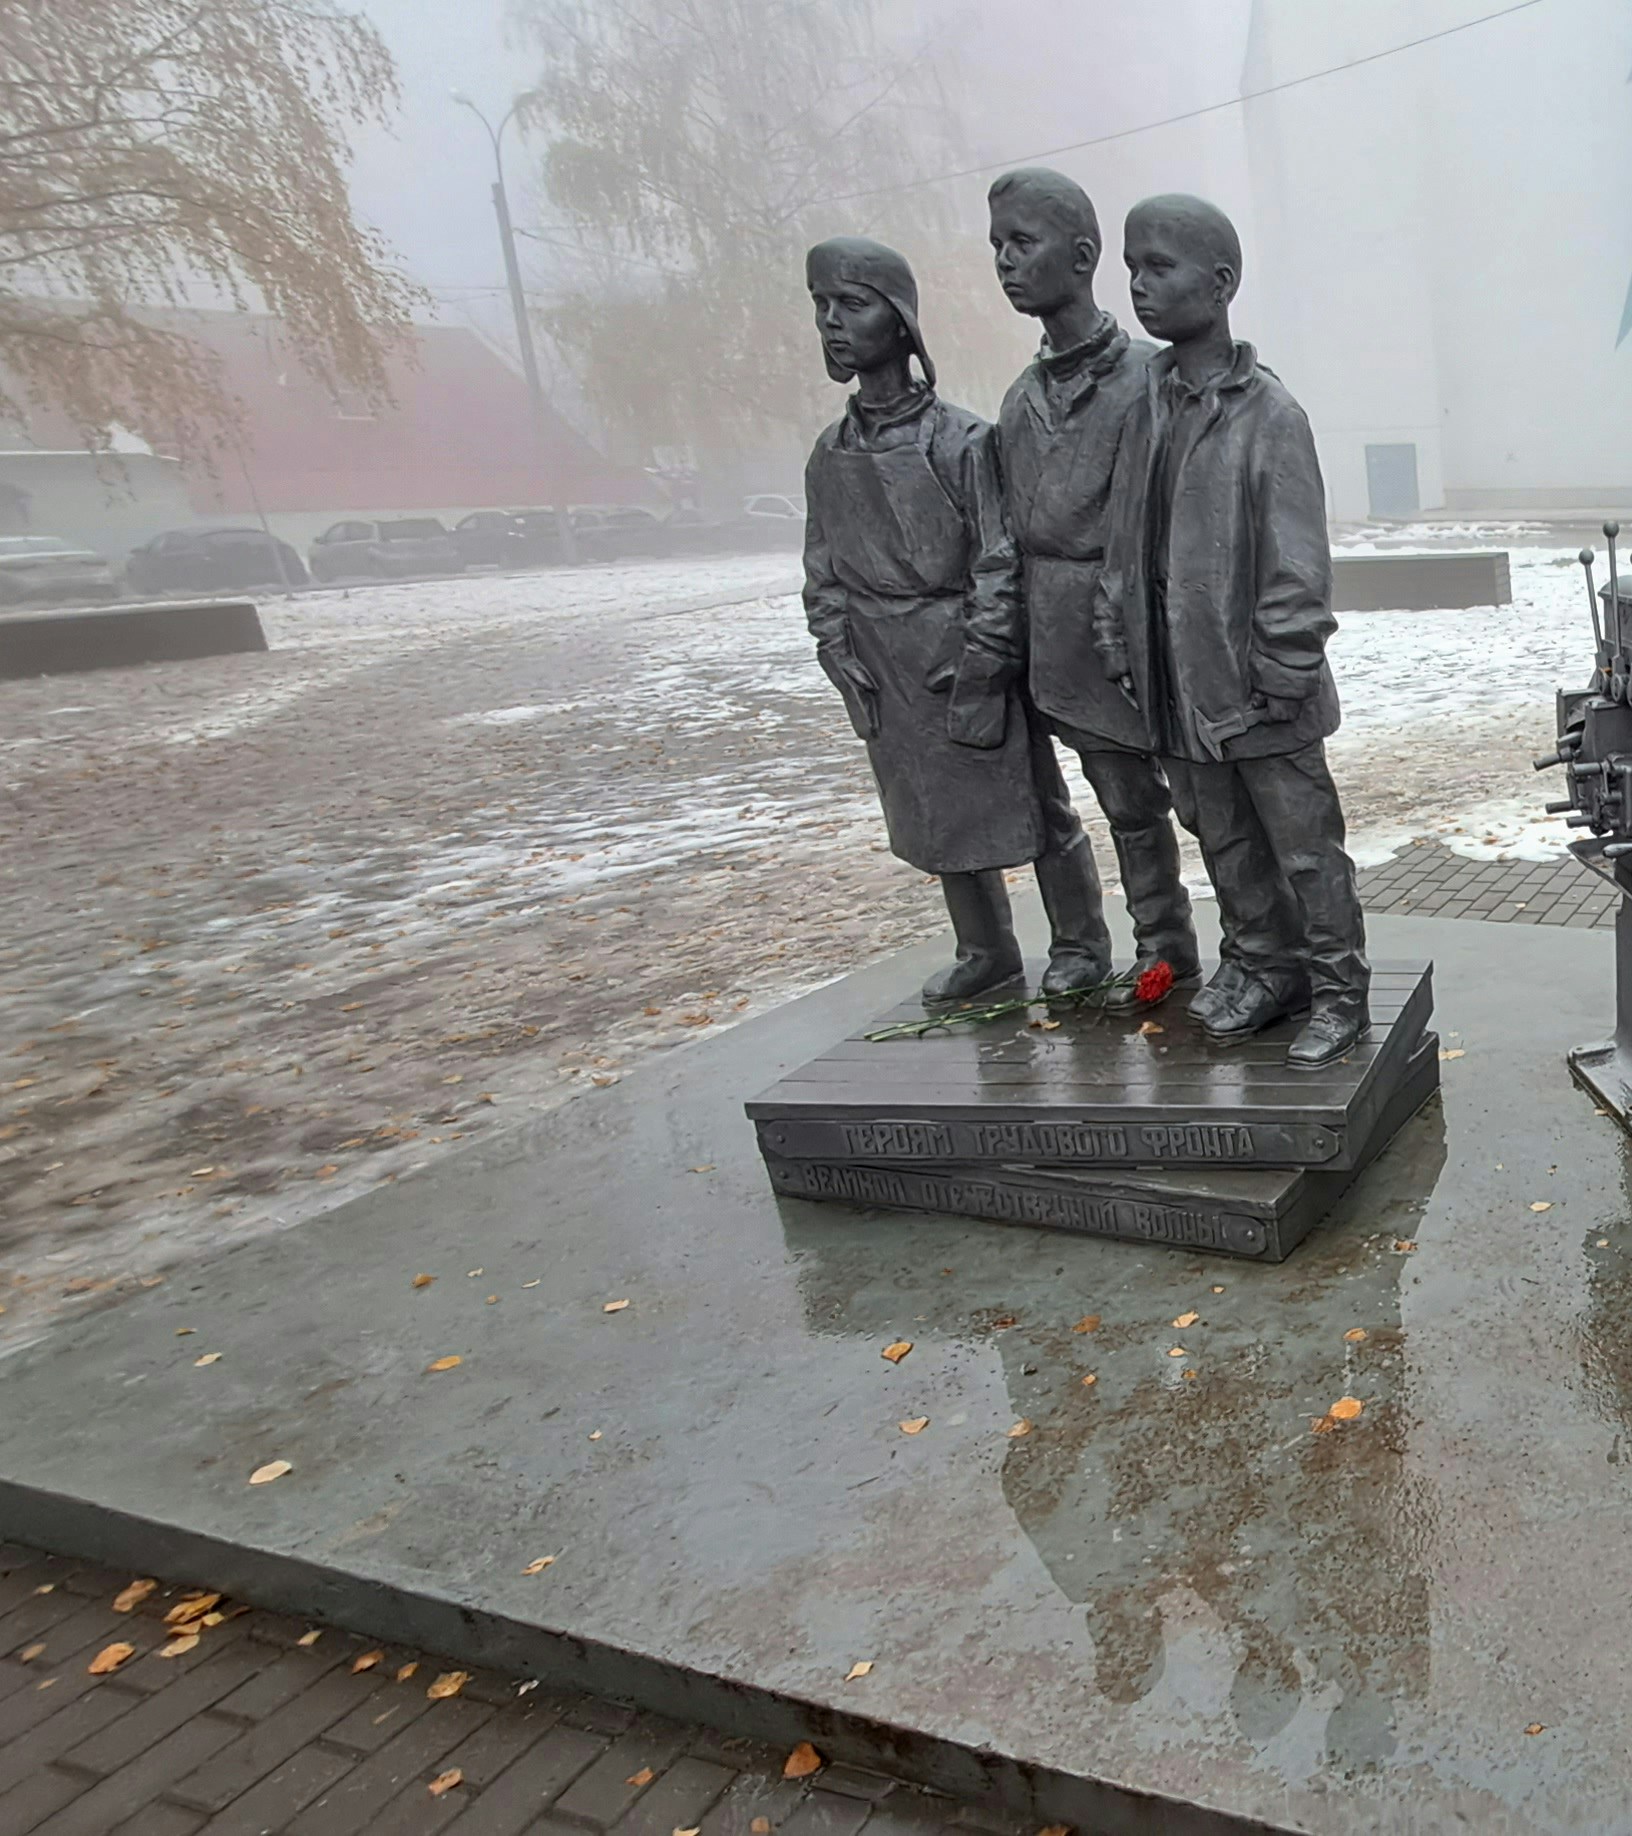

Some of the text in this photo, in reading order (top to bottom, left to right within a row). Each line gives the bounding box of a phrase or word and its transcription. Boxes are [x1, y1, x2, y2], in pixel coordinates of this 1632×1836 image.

[840, 1124, 1256, 1158] ГЕРОЯМ ТРУДОВОГО ФРОНТА
[920, 1179, 1118, 1233] ОТЕЧЕСТВЕННОЙ
[1133, 1203, 1221, 1246] ВОЙНЫ
